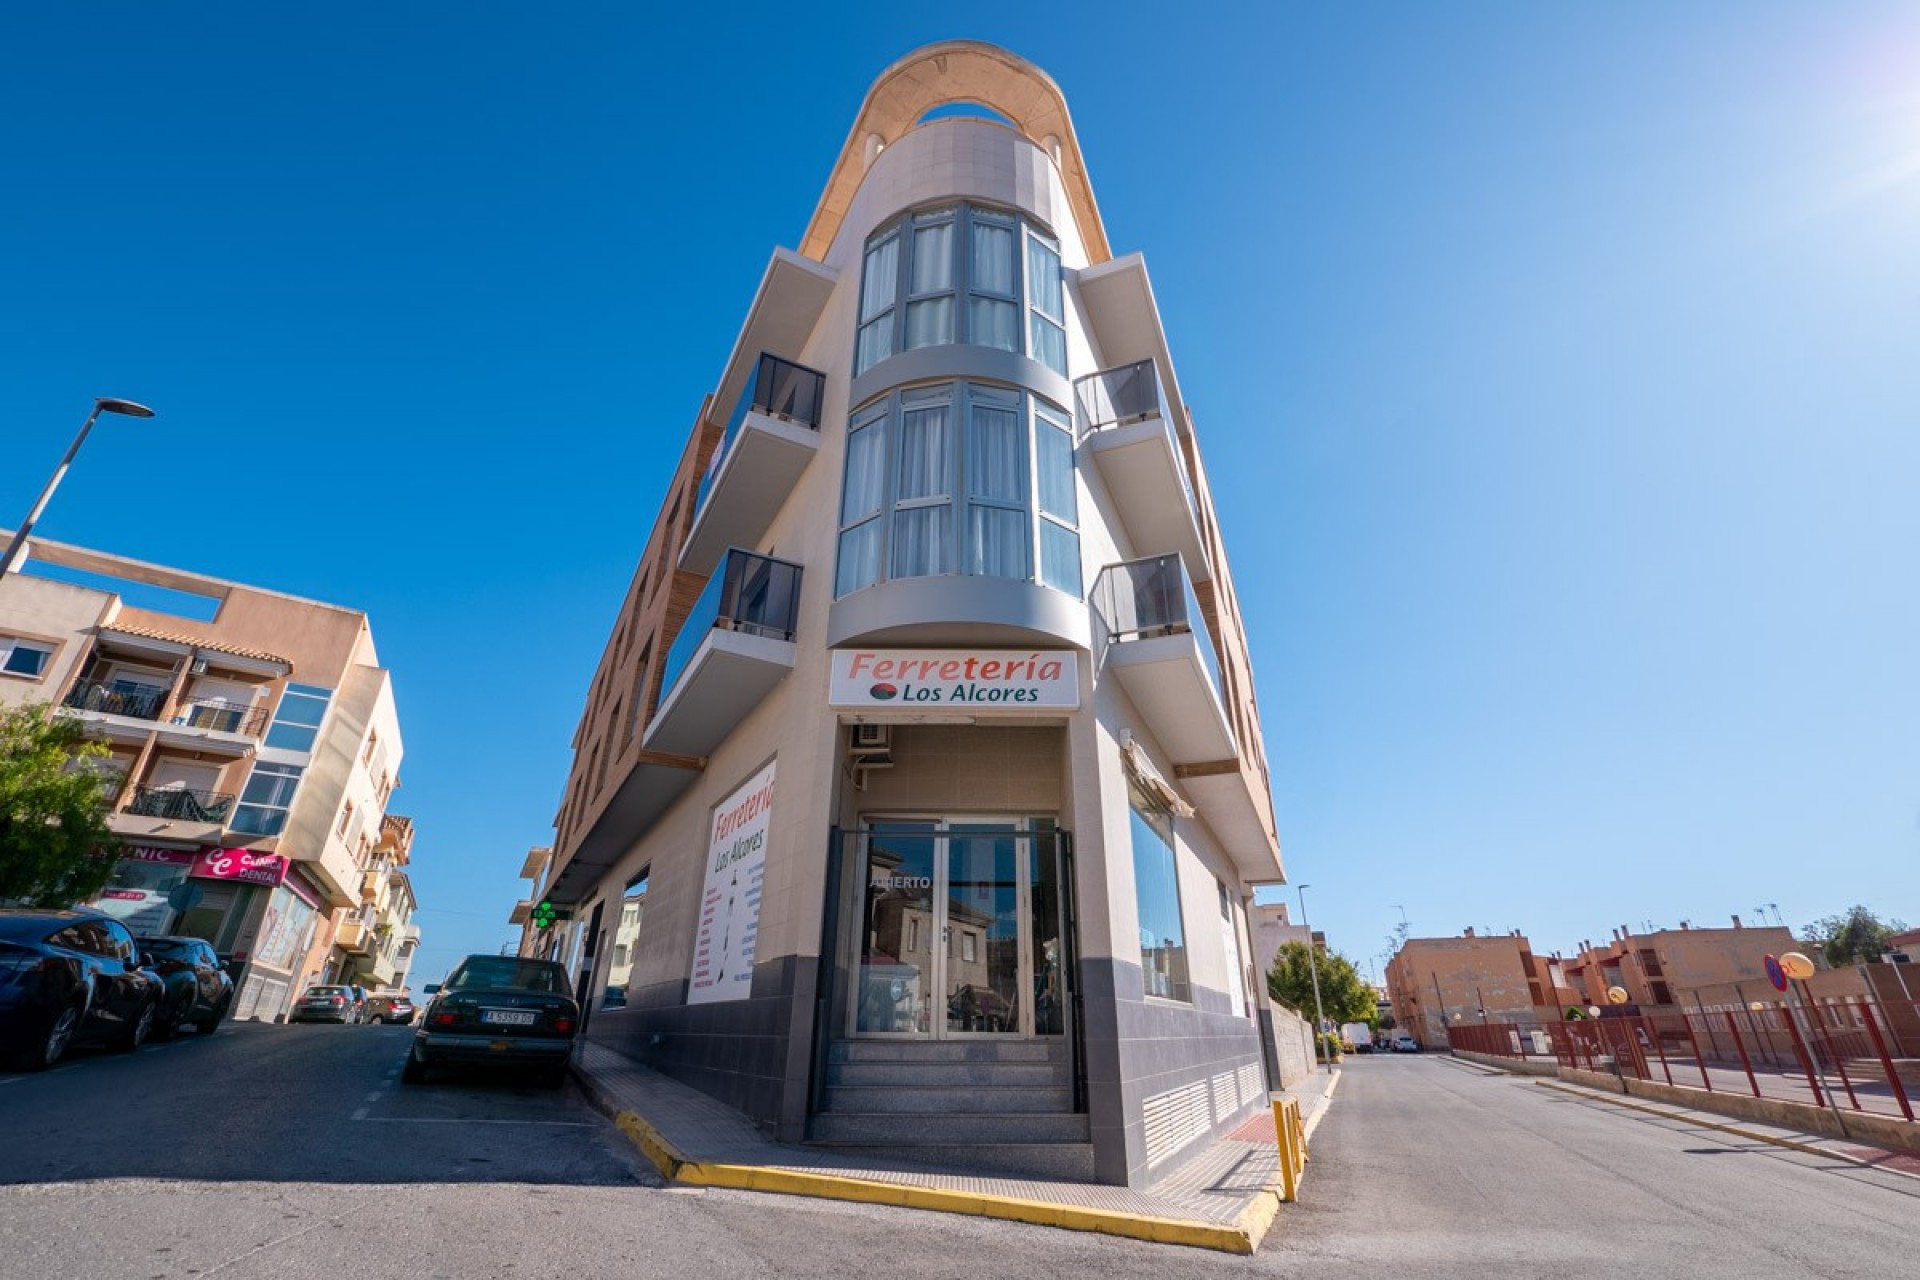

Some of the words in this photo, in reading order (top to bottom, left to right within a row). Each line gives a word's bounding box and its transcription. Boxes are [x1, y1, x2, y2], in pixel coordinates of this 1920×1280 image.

[848, 651, 1063, 681] Ferretería
[902, 684, 943, 702] Los
[950, 683, 1039, 702] Alcores
[729, 827, 764, 865] Alcores
